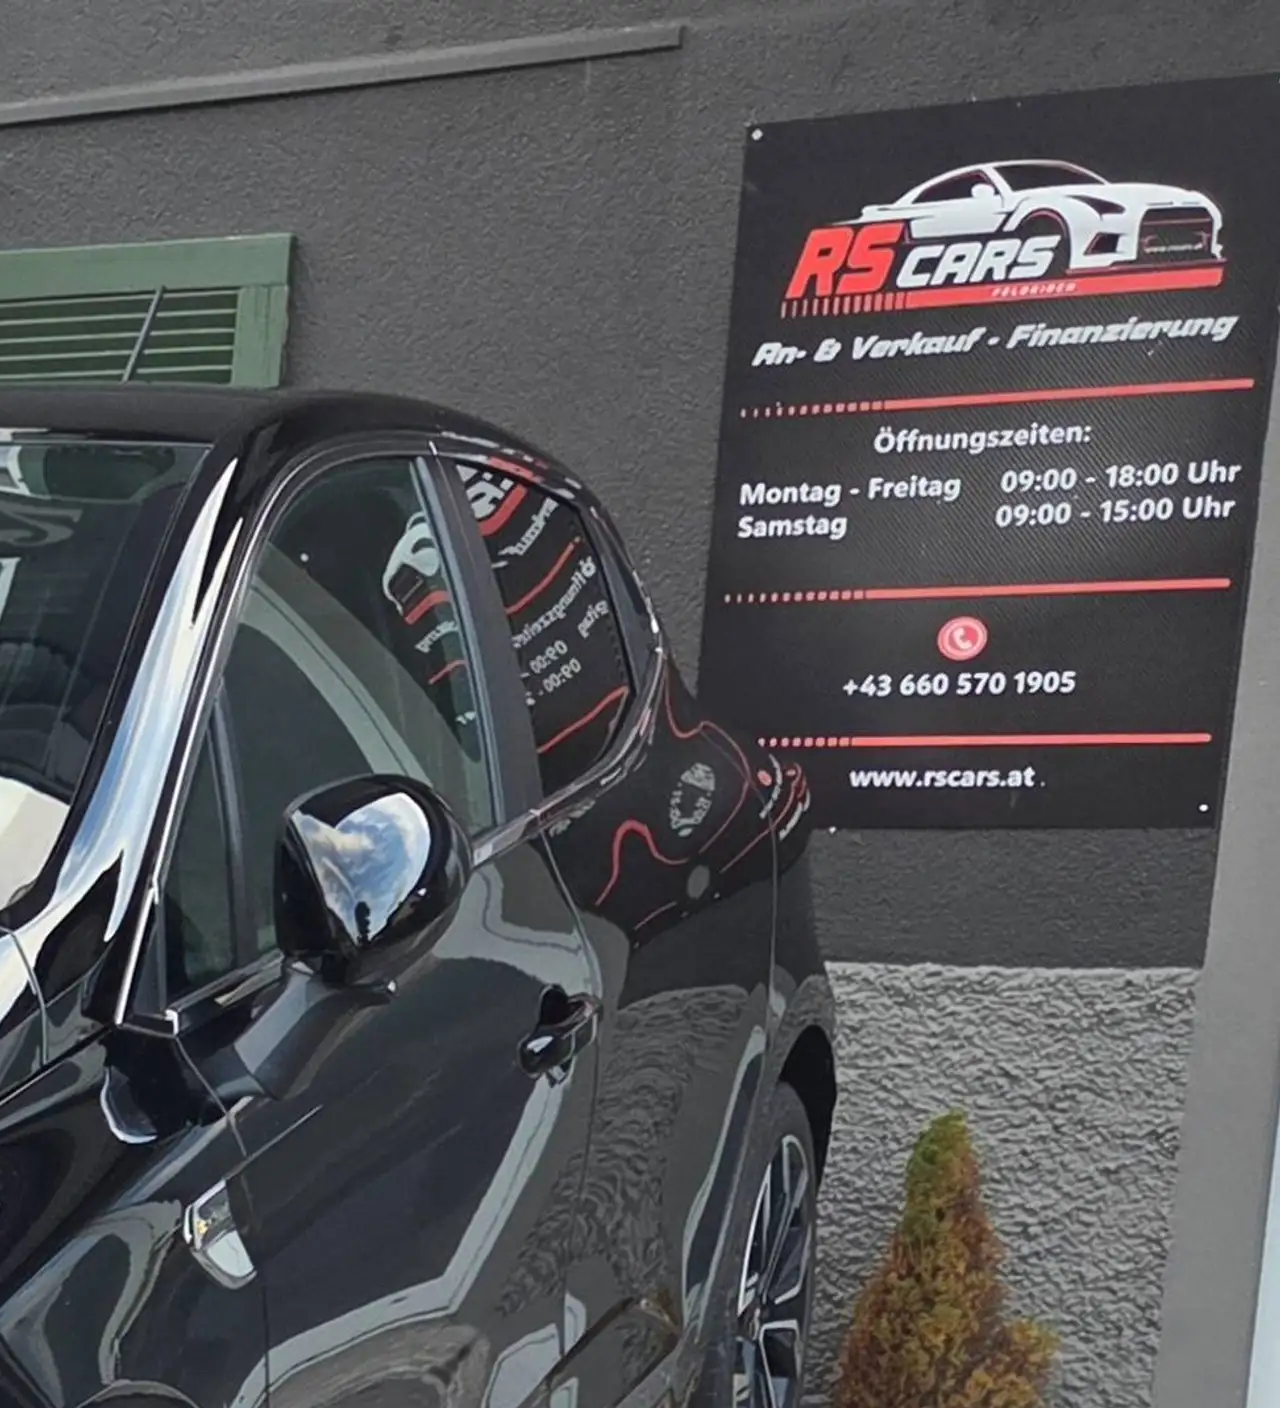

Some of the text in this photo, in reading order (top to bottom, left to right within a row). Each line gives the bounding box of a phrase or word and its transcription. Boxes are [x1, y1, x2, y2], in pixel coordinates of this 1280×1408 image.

[785, 222, 903, 299] RS
[897, 236, 1061, 288] CARS
[751, 341, 807, 367] An-
[814, 338, 841, 362] &
[852, 327, 983, 359] Verkauf
[1006, 315, 1239, 349] Finanzierung
[873, 423, 1093, 456] Öffnungszeiten:
[739, 482, 842, 508] Montag
[867, 475, 962, 501] Freitag
[999, 466, 1078, 494] 09:00
[1104, 461, 1180, 489] 18:00
[1187, 460, 1242, 485] Uhr
[737, 514, 848, 541] Samstag
[994, 501, 1073, 529] 09:00
[1099, 496, 1174, 524] 15:00
[1182, 494, 1237, 520] Uhr
[842, 670, 1077, 697] +43 660 570 1905
[849, 766, 1036, 788] www.rscars.at
